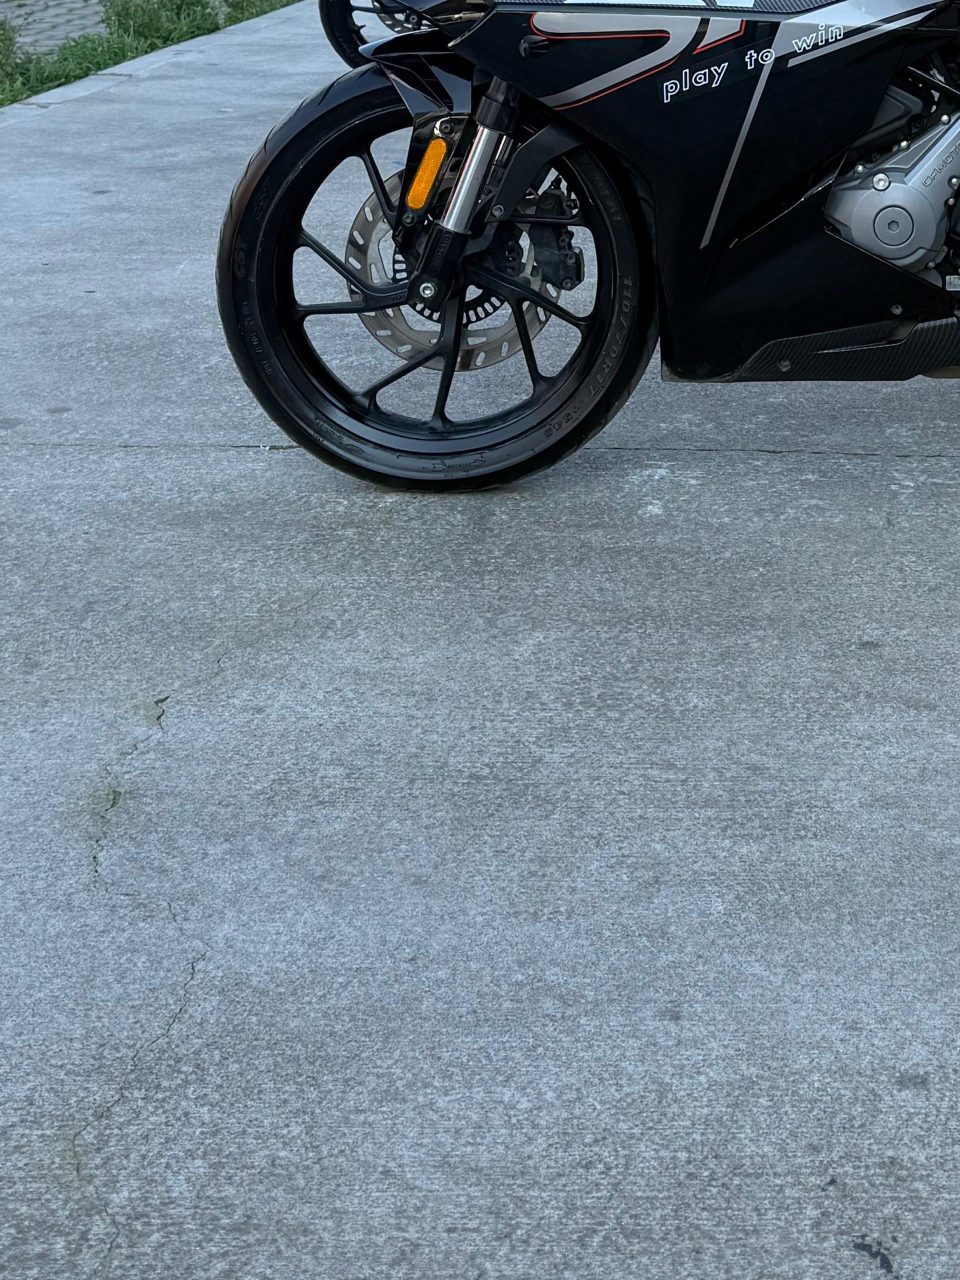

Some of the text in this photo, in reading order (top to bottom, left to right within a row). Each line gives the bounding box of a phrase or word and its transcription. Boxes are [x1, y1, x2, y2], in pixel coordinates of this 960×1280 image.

[663, 23, 844, 103] play to win
